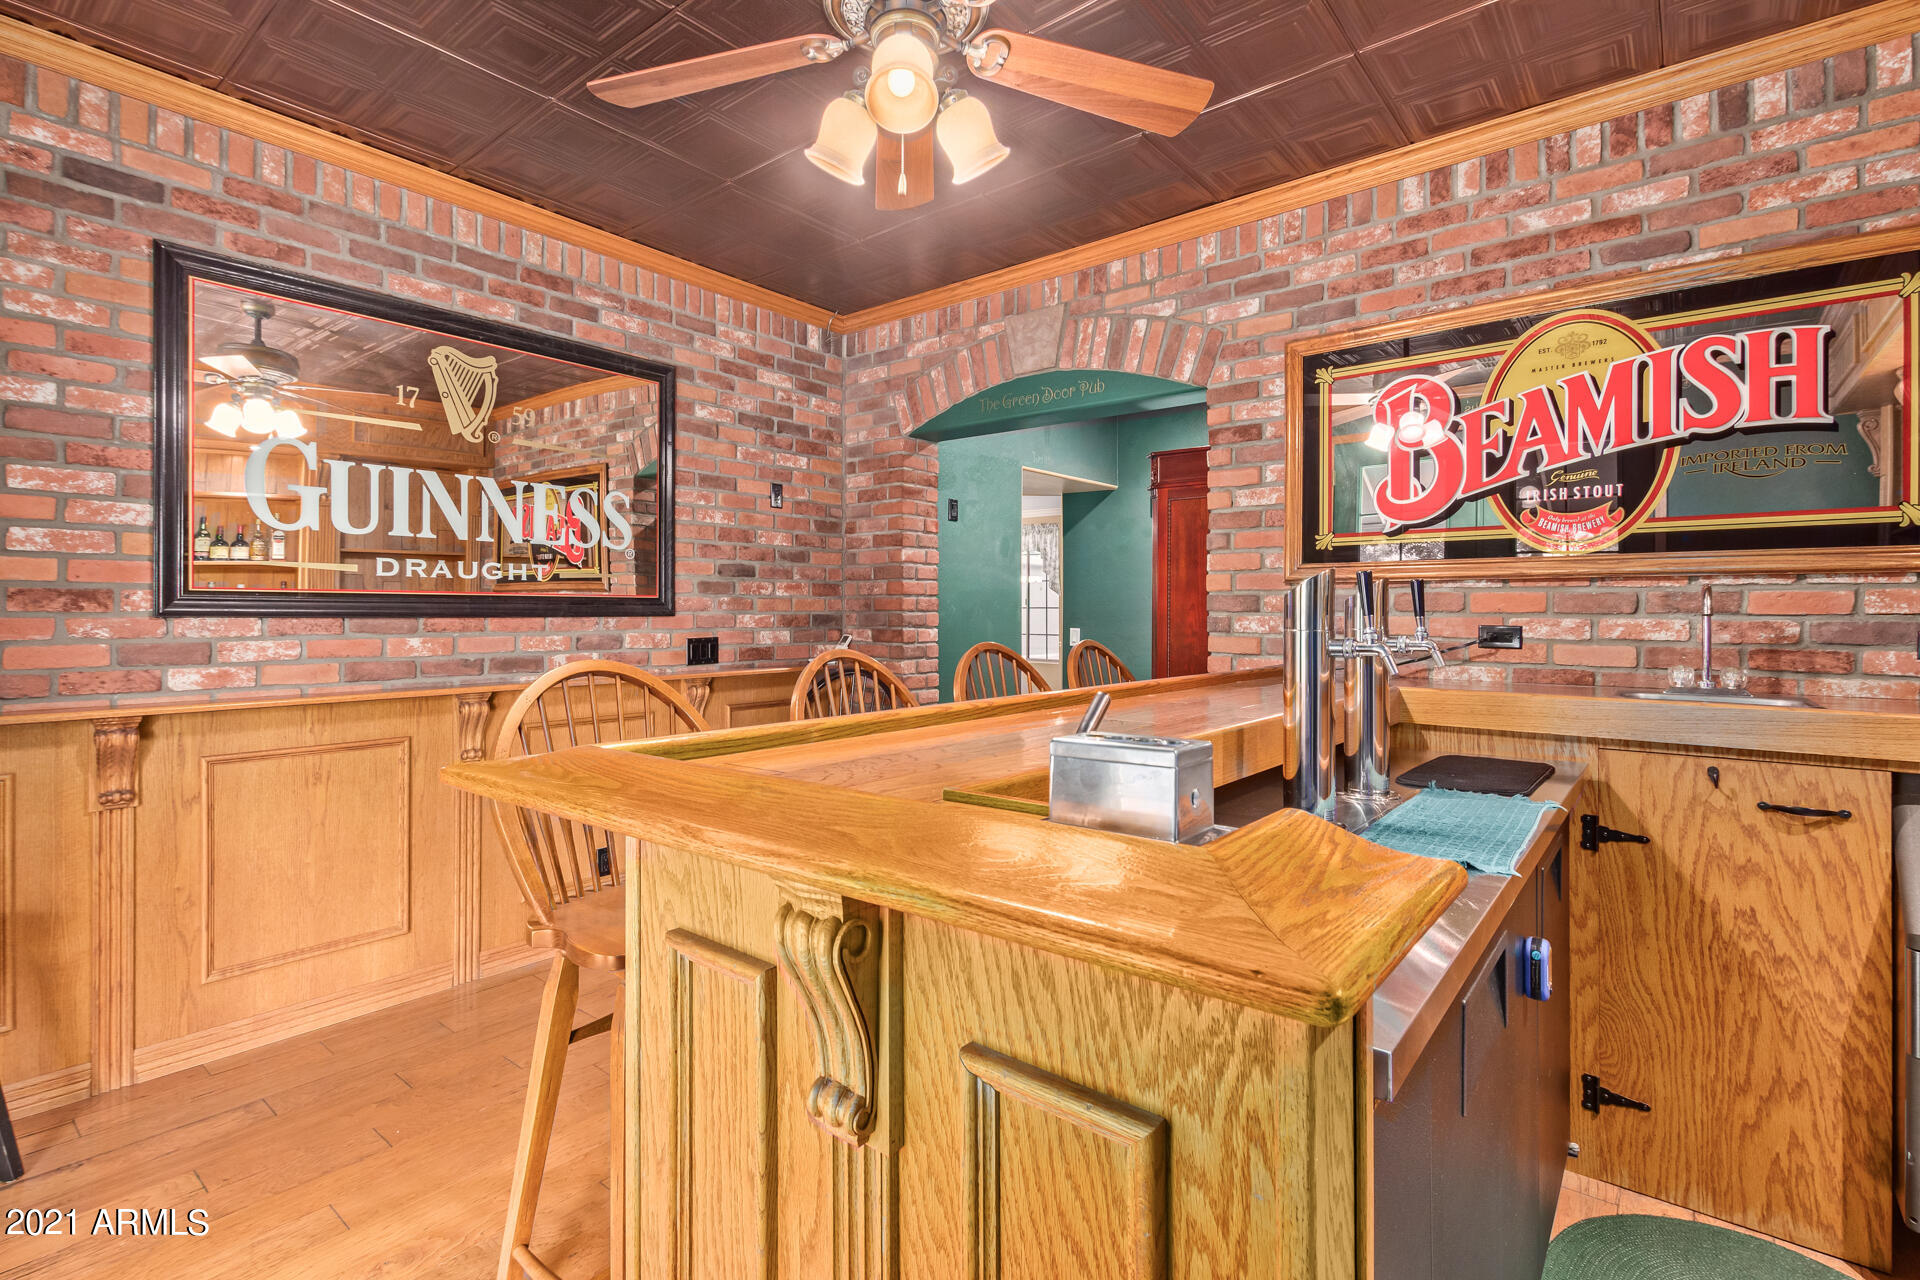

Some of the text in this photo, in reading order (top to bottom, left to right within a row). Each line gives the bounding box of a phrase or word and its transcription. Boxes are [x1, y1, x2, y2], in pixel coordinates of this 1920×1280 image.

[1538, 347, 1553, 355] EST.
[1531, 356, 1615, 373] MASTER BREWERS
[395, 384, 420, 409] 17
[979, 378, 1105, 415] The Green Door Pub
[512, 406, 536, 428] 59
[1373, 324, 1836, 533] BEAMISH
[1680, 443, 1849, 467] IMPORTED FROM
[1712, 457, 1807, 475] IRELAND
[1545, 468, 1600, 487] Genuine
[245, 437, 631, 551] GUINNESS
[1525, 483, 1624, 501] IRISH STOUT
[1538, 515, 1606, 532] BEAMISH BREWERY
[375, 556, 549, 582] DRAUGHT
